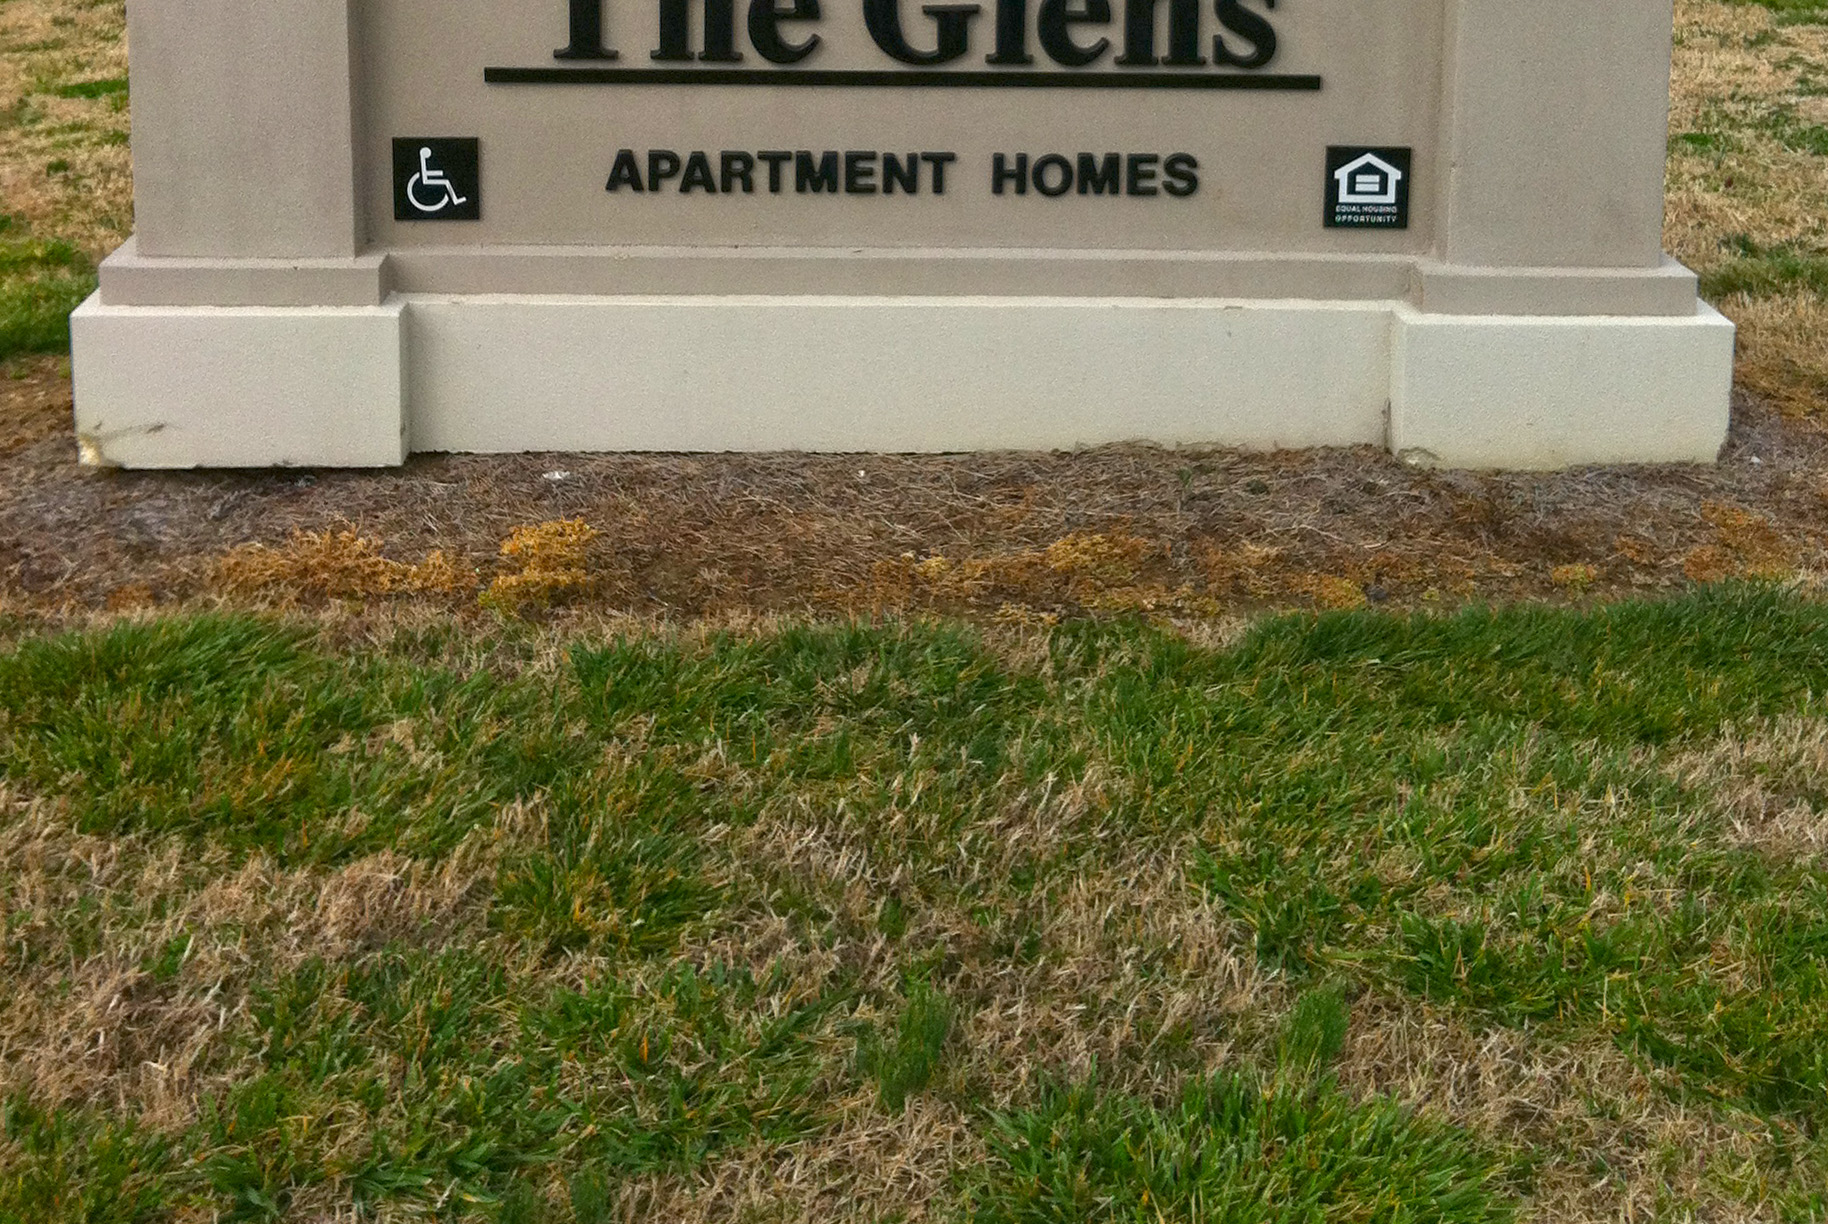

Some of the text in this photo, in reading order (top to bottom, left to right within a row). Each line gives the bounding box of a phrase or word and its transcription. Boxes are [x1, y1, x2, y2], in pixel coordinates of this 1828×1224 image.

[605, 149, 1199, 197] APARTMENT HOMES
[1335, 205, 1361, 213] EQUAL
[1335, 214, 1397, 223] OPPORTUNITY
